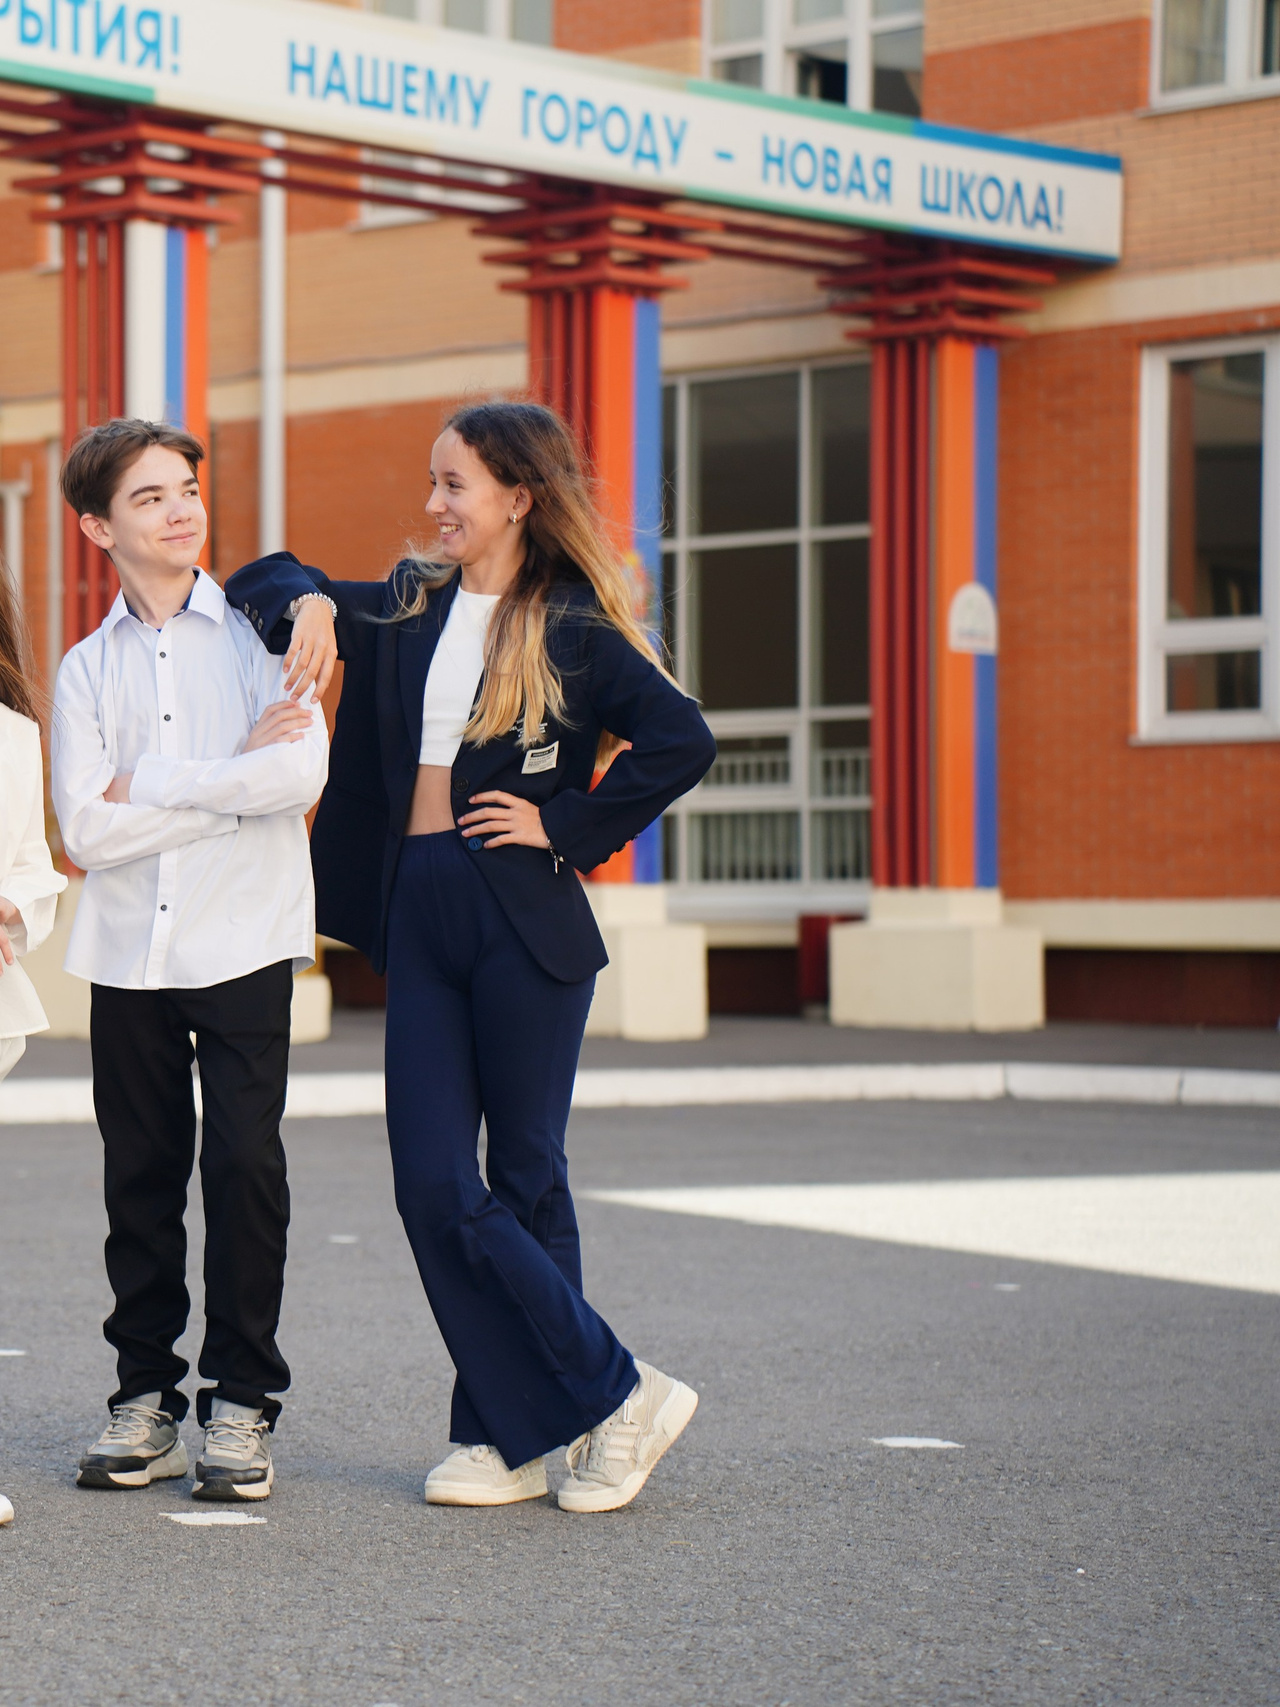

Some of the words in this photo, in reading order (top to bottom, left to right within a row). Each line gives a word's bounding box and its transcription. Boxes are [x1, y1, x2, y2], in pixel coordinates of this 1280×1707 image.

[287, 41, 490, 129] НАШЕМУ
[521, 87, 688, 172] ГОРОДУ
[761, 135, 893, 205] НОВАЯ
[920, 164, 1065, 233] ШКОЛА!
